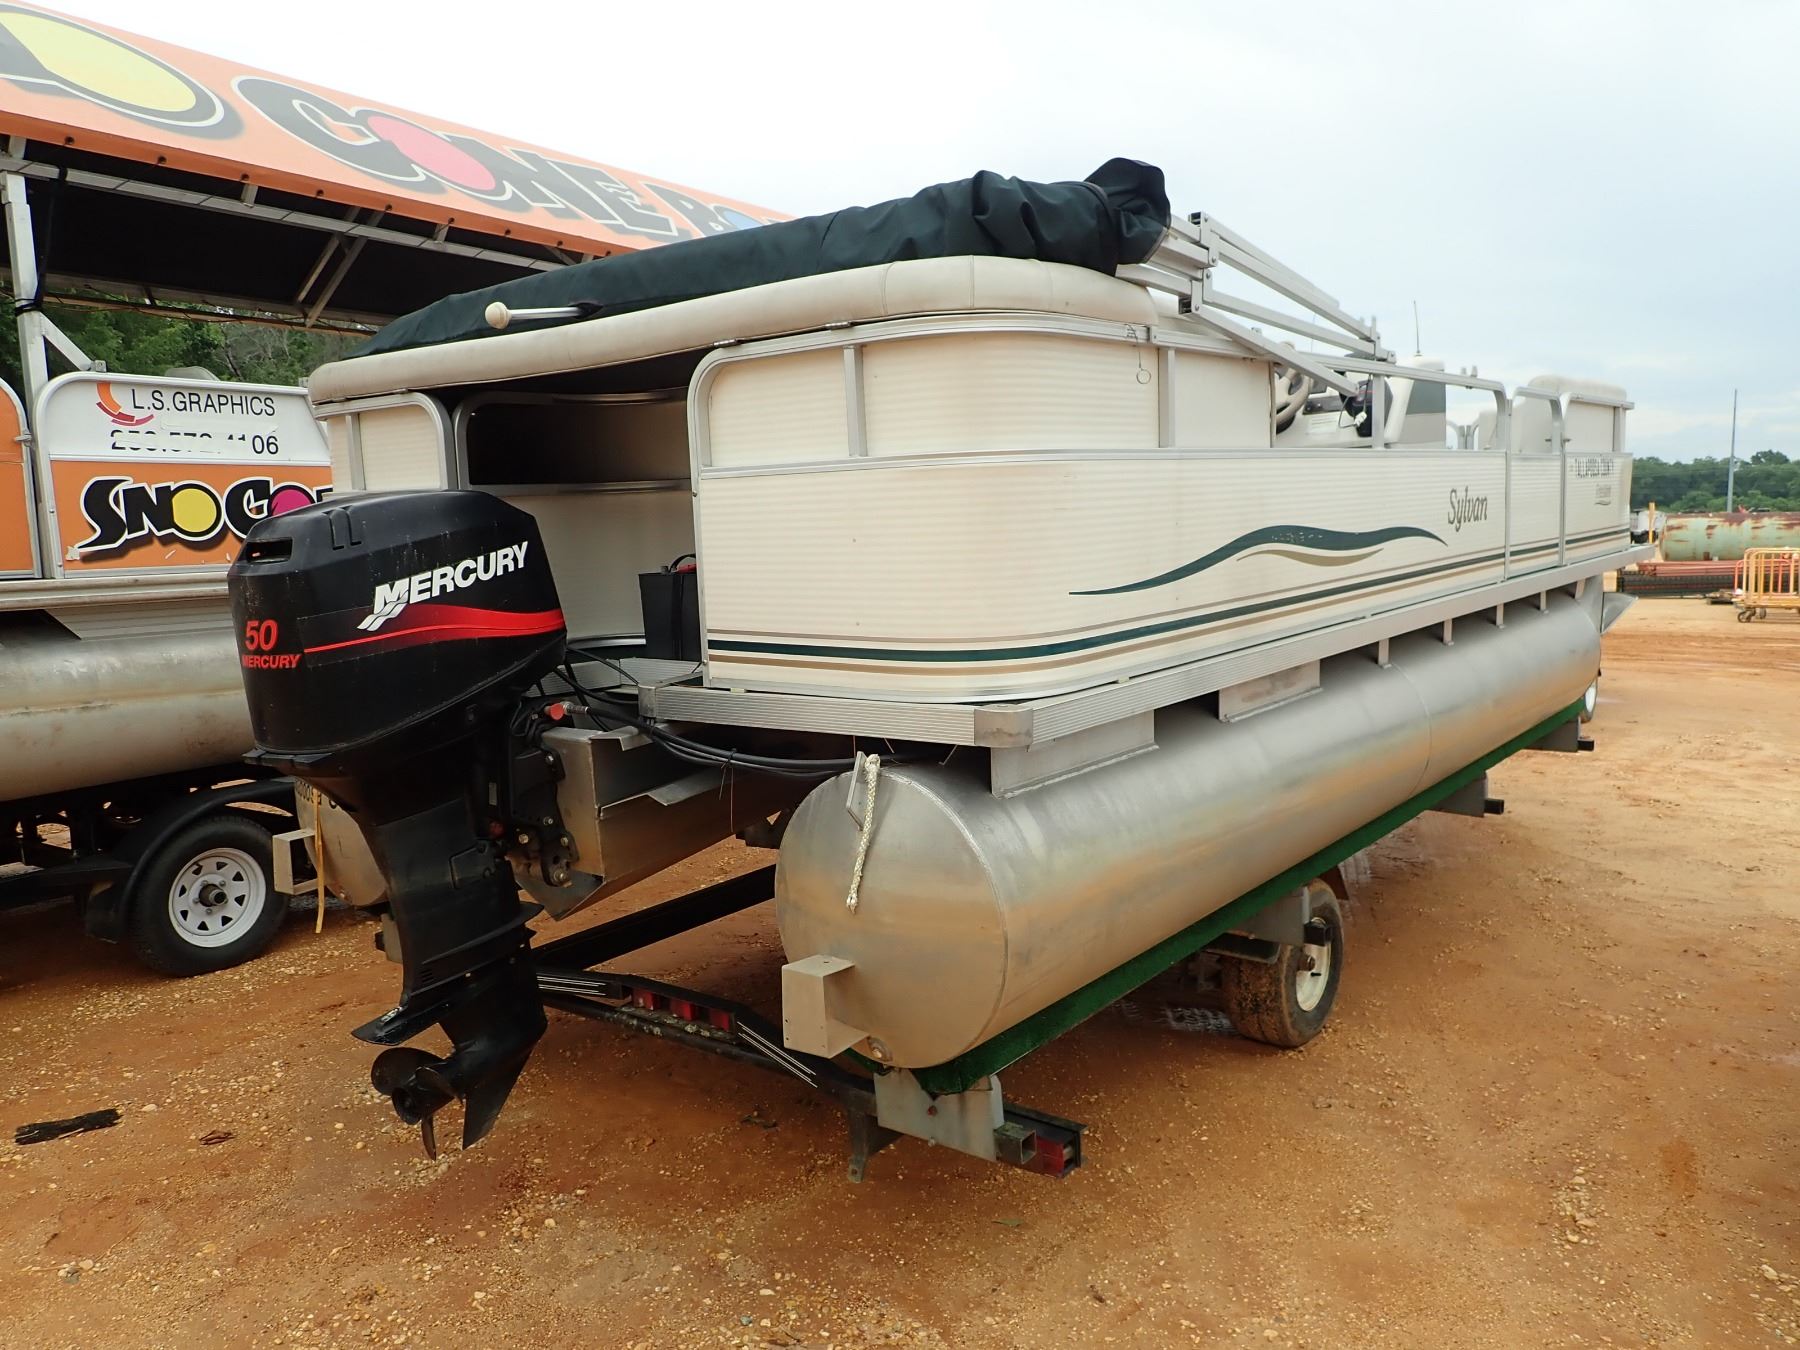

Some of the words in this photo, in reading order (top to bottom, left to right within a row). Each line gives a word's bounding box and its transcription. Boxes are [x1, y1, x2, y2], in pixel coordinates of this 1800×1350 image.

[1448, 485, 1488, 532] Sylvan
[357, 541, 529, 632] MERCURY
[245, 619, 278, 650] 50
[242, 654, 302, 669] MERCURY
